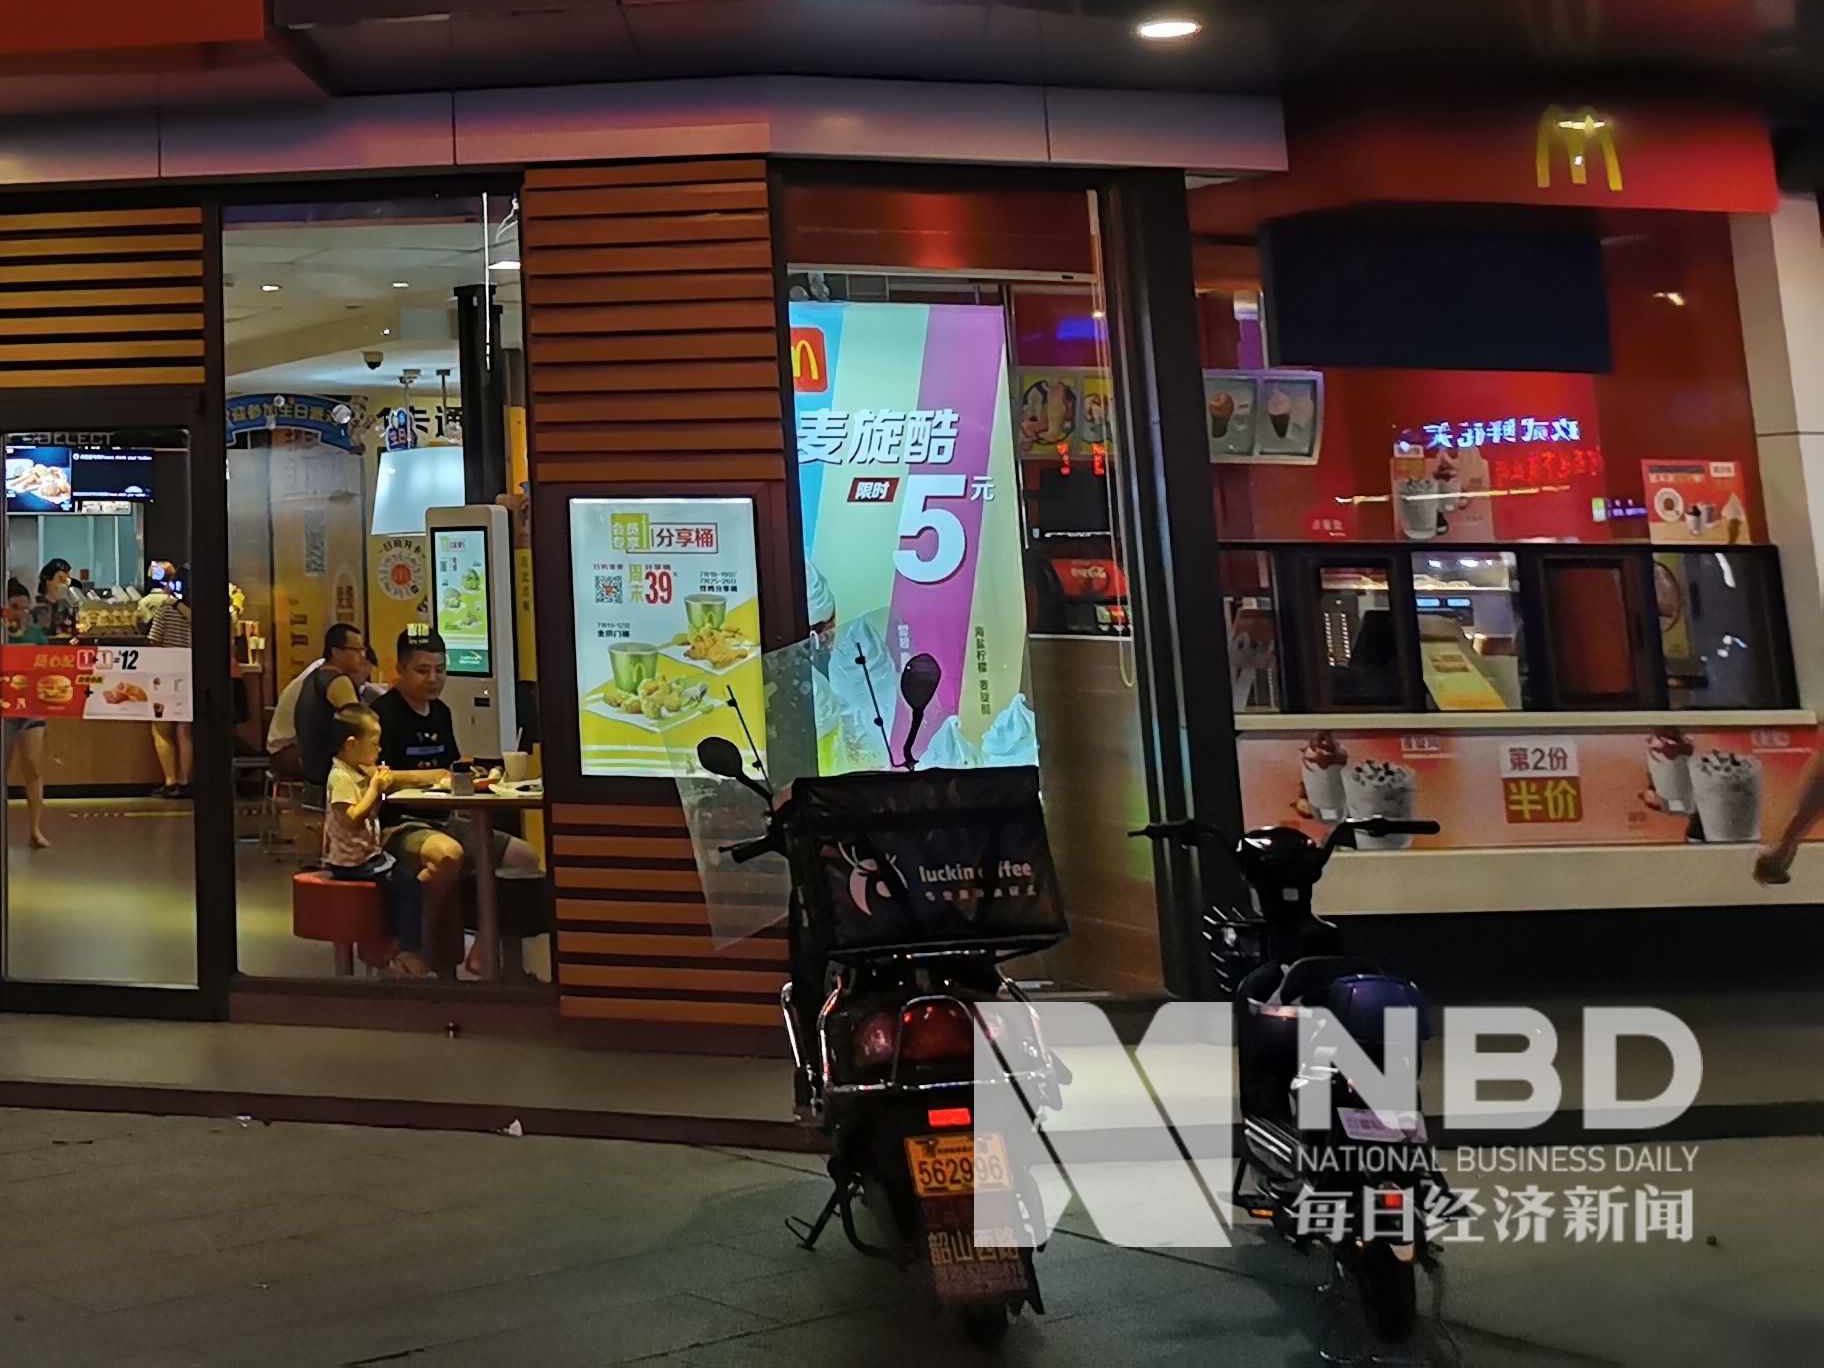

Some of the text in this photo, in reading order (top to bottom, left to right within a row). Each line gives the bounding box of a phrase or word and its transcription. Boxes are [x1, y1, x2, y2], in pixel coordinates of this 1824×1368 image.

[797, 407, 961, 466] 麦旋酷
[854, 481, 890, 500] 限时
[656, 527, 714, 548] 分享桶
[892, 474, 996, 586] 5 元
[644, 571, 673, 605] 39
[1508, 746, 1569, 772] 第2份
[1508, 779, 1578, 820] 半价
[918, 864, 975, 884] luckin
[918, 1155, 1004, 1186] 562996
